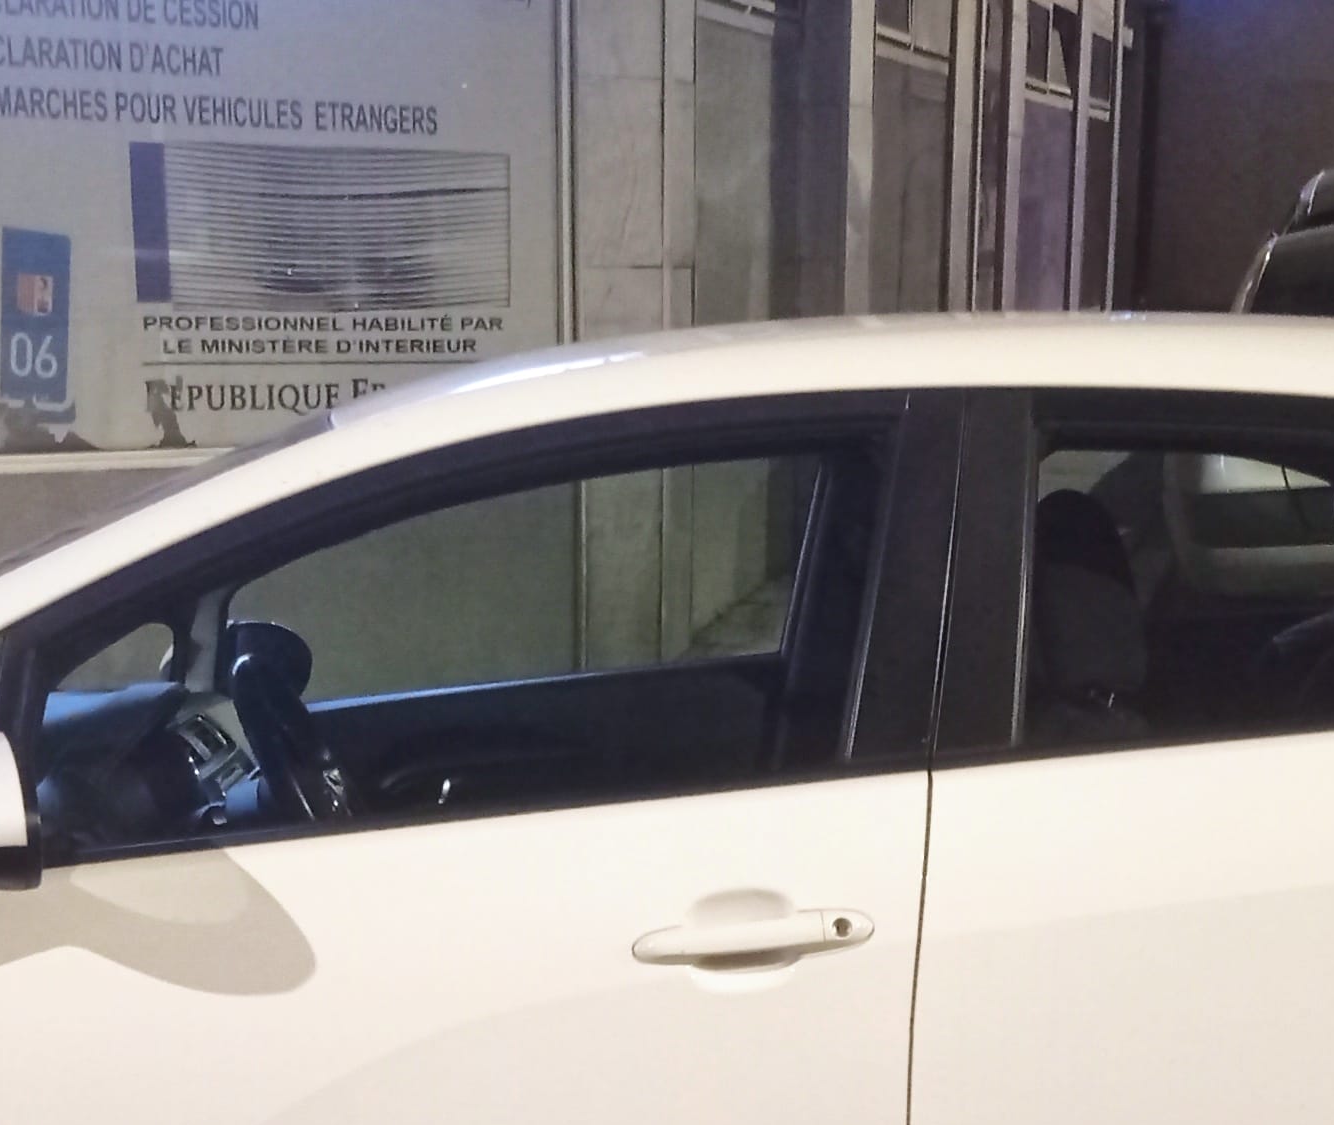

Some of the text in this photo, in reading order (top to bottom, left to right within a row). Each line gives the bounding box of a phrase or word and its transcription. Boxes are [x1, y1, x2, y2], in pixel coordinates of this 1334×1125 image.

[126, 0, 156, 24] DE
[162, 0, 259, 31] CESSION
[129, 41, 223, 77] D'ACHAT
[116, 91, 176, 125] POUR
[185, 96, 303, 130] VEHICULES
[315, 102, 438, 135] ETRANGERS
[142, 315, 503, 332] PROFESSIONNEL HABILITÉ PAR
[10, 331, 58, 379] 06
[162, 338, 193, 354] LE
[336, 338, 477, 354] D'INTERIEUR
